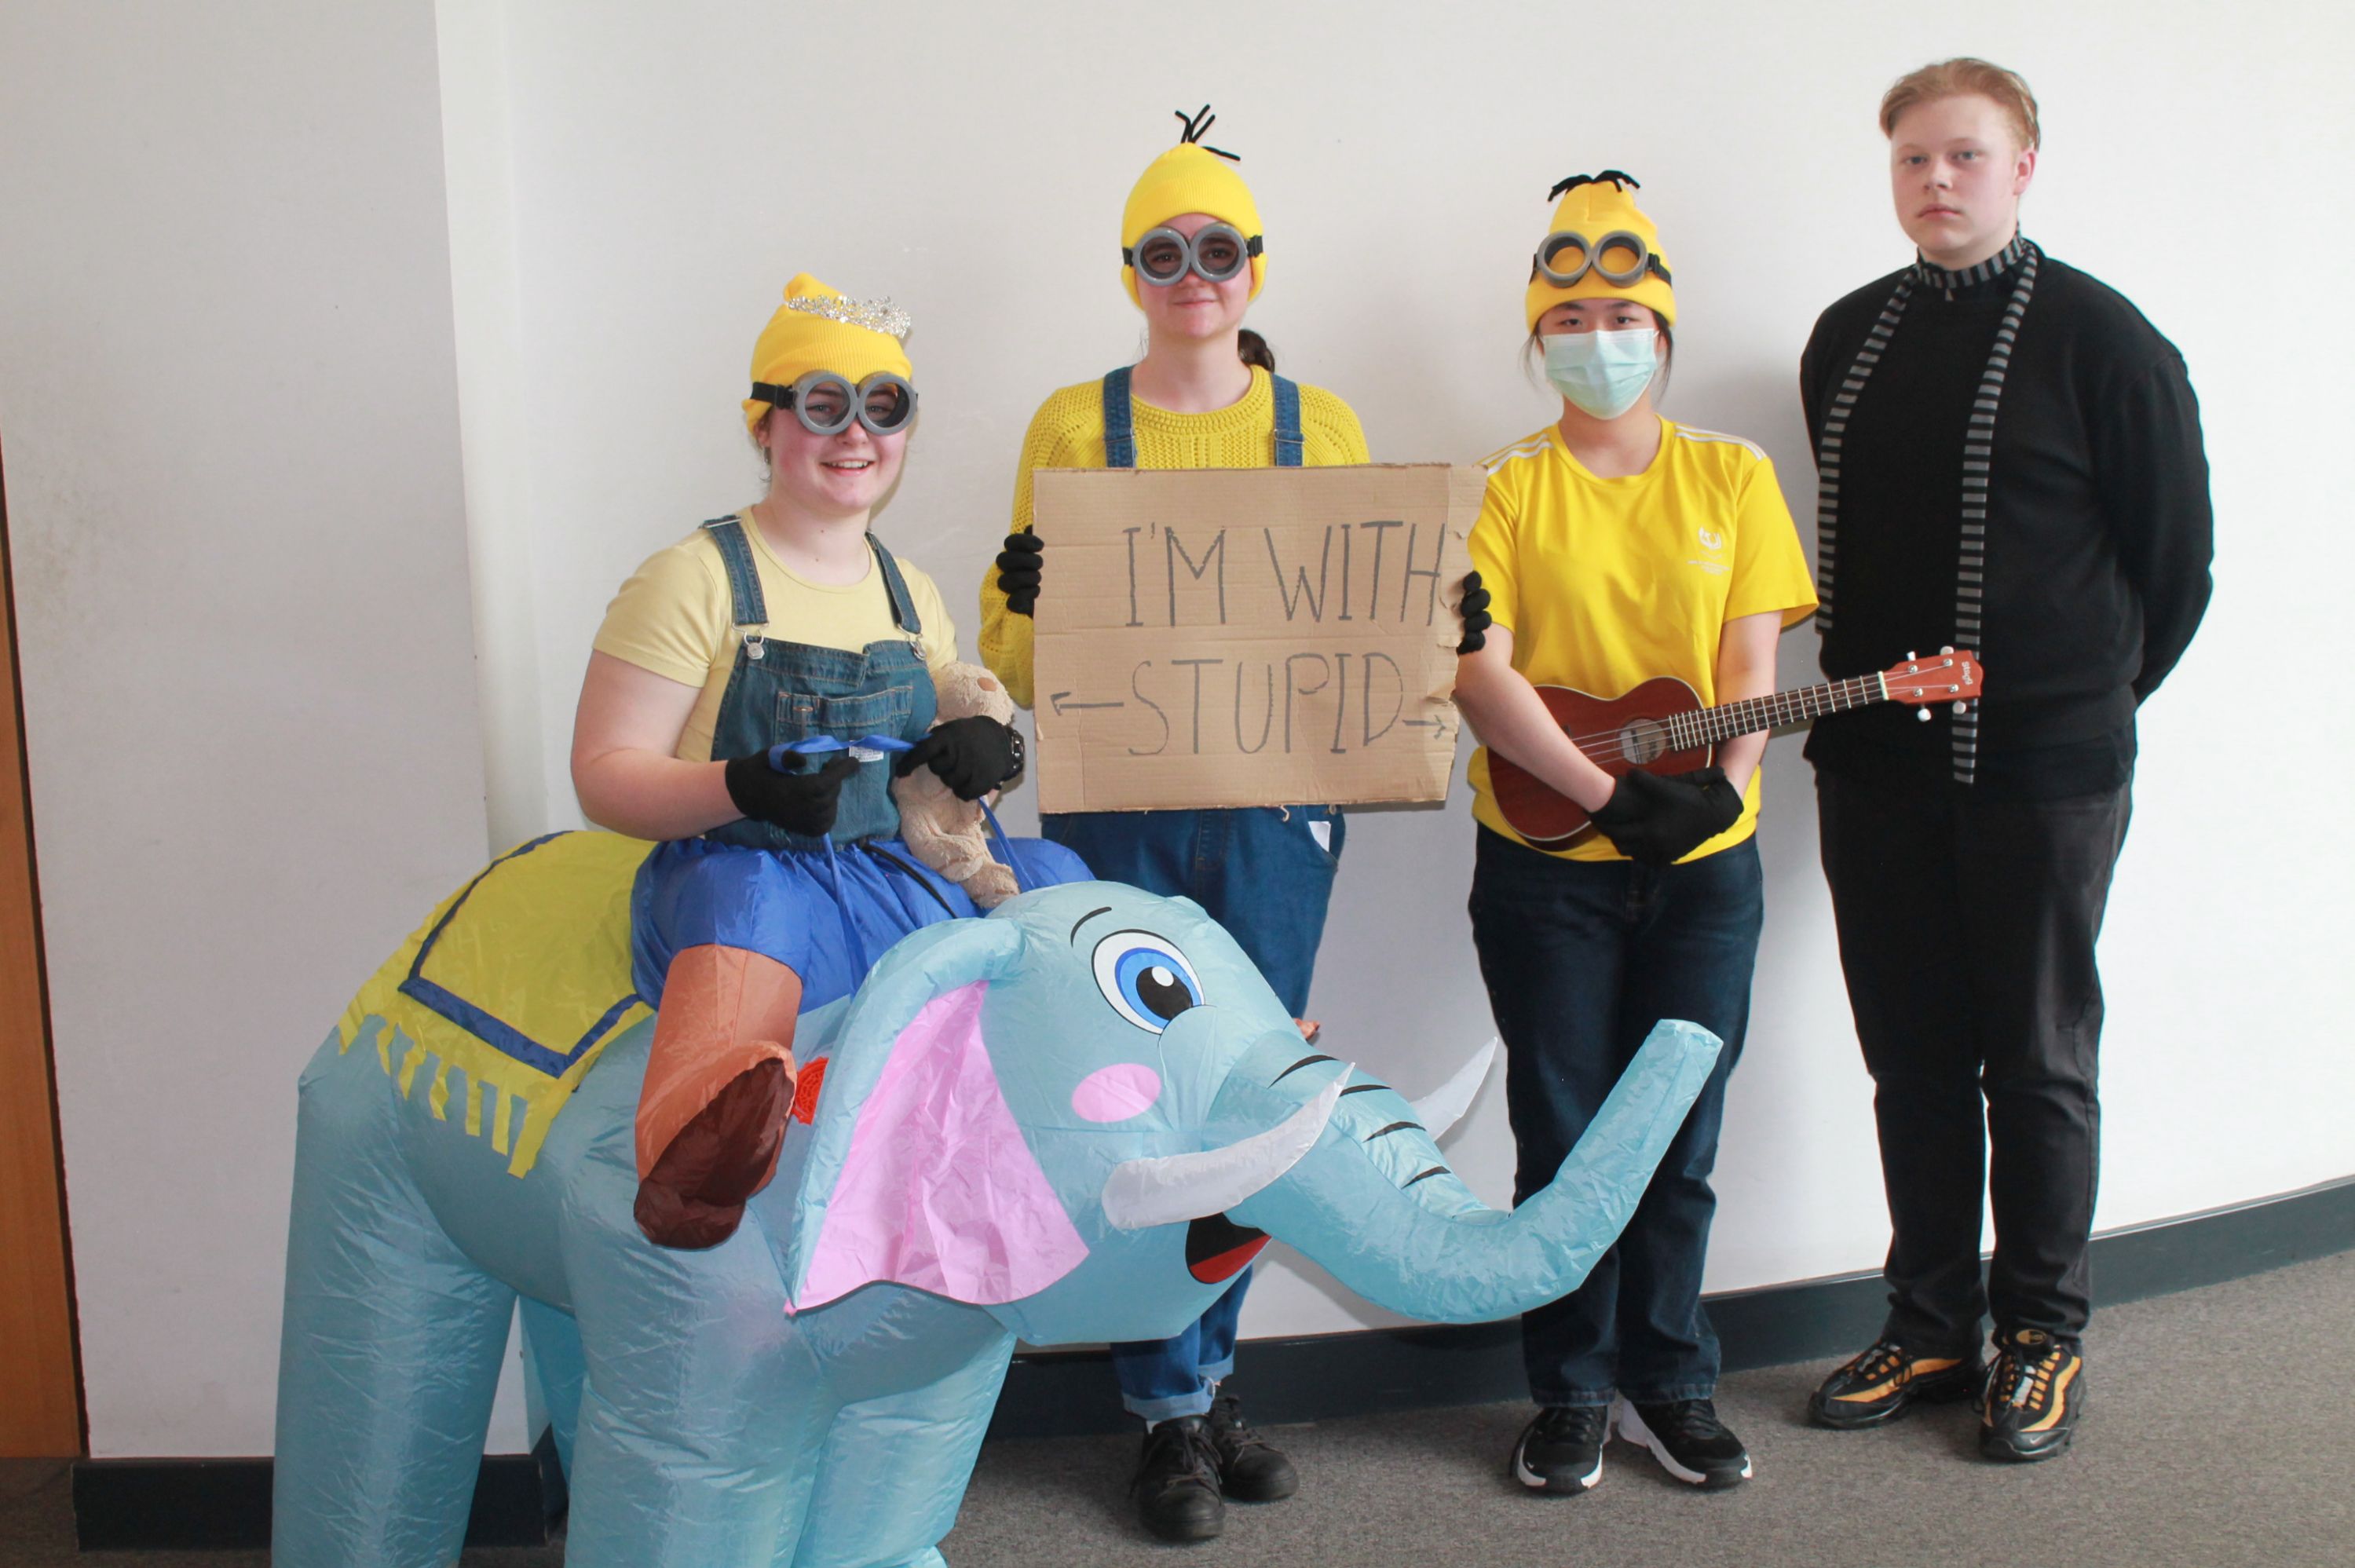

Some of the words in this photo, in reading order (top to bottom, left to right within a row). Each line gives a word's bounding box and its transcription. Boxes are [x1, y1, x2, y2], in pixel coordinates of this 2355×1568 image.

[1122, 521, 1227, 627] I'M
[1263, 520, 1446, 627] WITH
[1126, 652, 1404, 756] STUPID
